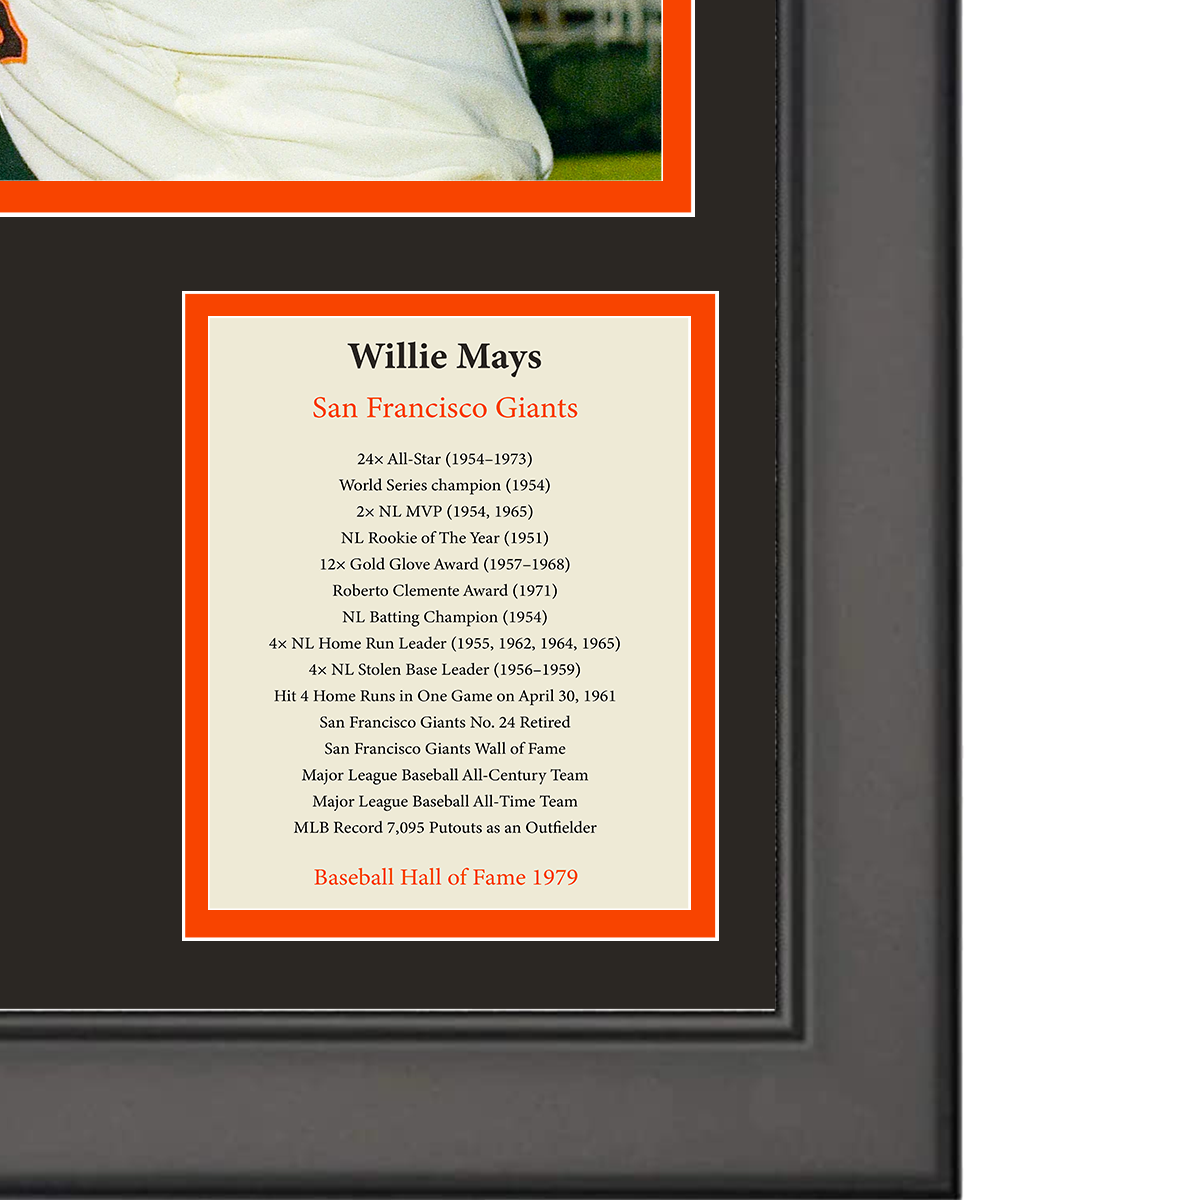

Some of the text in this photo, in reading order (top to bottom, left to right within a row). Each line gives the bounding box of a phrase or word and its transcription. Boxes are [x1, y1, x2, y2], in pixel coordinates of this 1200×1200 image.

[346, 340, 542, 378] Willie Mays
[312, 396, 579, 419] San Francisco Giants
[386, 451, 442, 466] All-Star
[338, 477, 551, 496] World Series champion (1954)
[378, 504, 403, 518] NL
[405, 504, 443, 518] MVP
[446, 503, 490, 521] (1954,
[495, 503, 534, 521] 1965)
[340, 530, 549, 547] NL Rookie of The Year (1951)
[349, 556, 386, 571] Gold
[389, 556, 431, 571] Glove
[433, 556, 479, 571] Award
[332, 583, 558, 600] Roberto Clemente Award (1971)
[342, 609, 548, 628] NL Batting Champion (1954)
[291, 636, 315, 650] NL
[318, 636, 362, 650] Home
[365, 636, 395, 650] Run
[398, 635, 448, 650] Leader
[451, 635, 495, 653] (1955,
[499, 636, 536, 652] 1962,
[541, 636, 578, 652] 1964,
[582, 635, 621, 653] 1965)
[331, 662, 355, 676] NL
[357, 662, 402, 676] Stolen
[405, 662, 438, 676] Base
[441, 662, 490, 676] Leader
[274, 688, 616, 707] Hit 4 Home Runs in One Game on April 30, 1961
[319, 714, 571, 729] San Francisco Giants No. 24 Retired
[324, 741, 567, 756] San Francisco Giants Wall of Fame
[301, 767, 589, 786] Major League Baseball All-Century Team
[312, 794, 578, 812] Major League Baseball All-Time Team
[293, 819, 598, 836] MLB Record 7,095 Putouts as an Outfielder
[313, 867, 579, 886] Baseball Hall of Fame 1979
